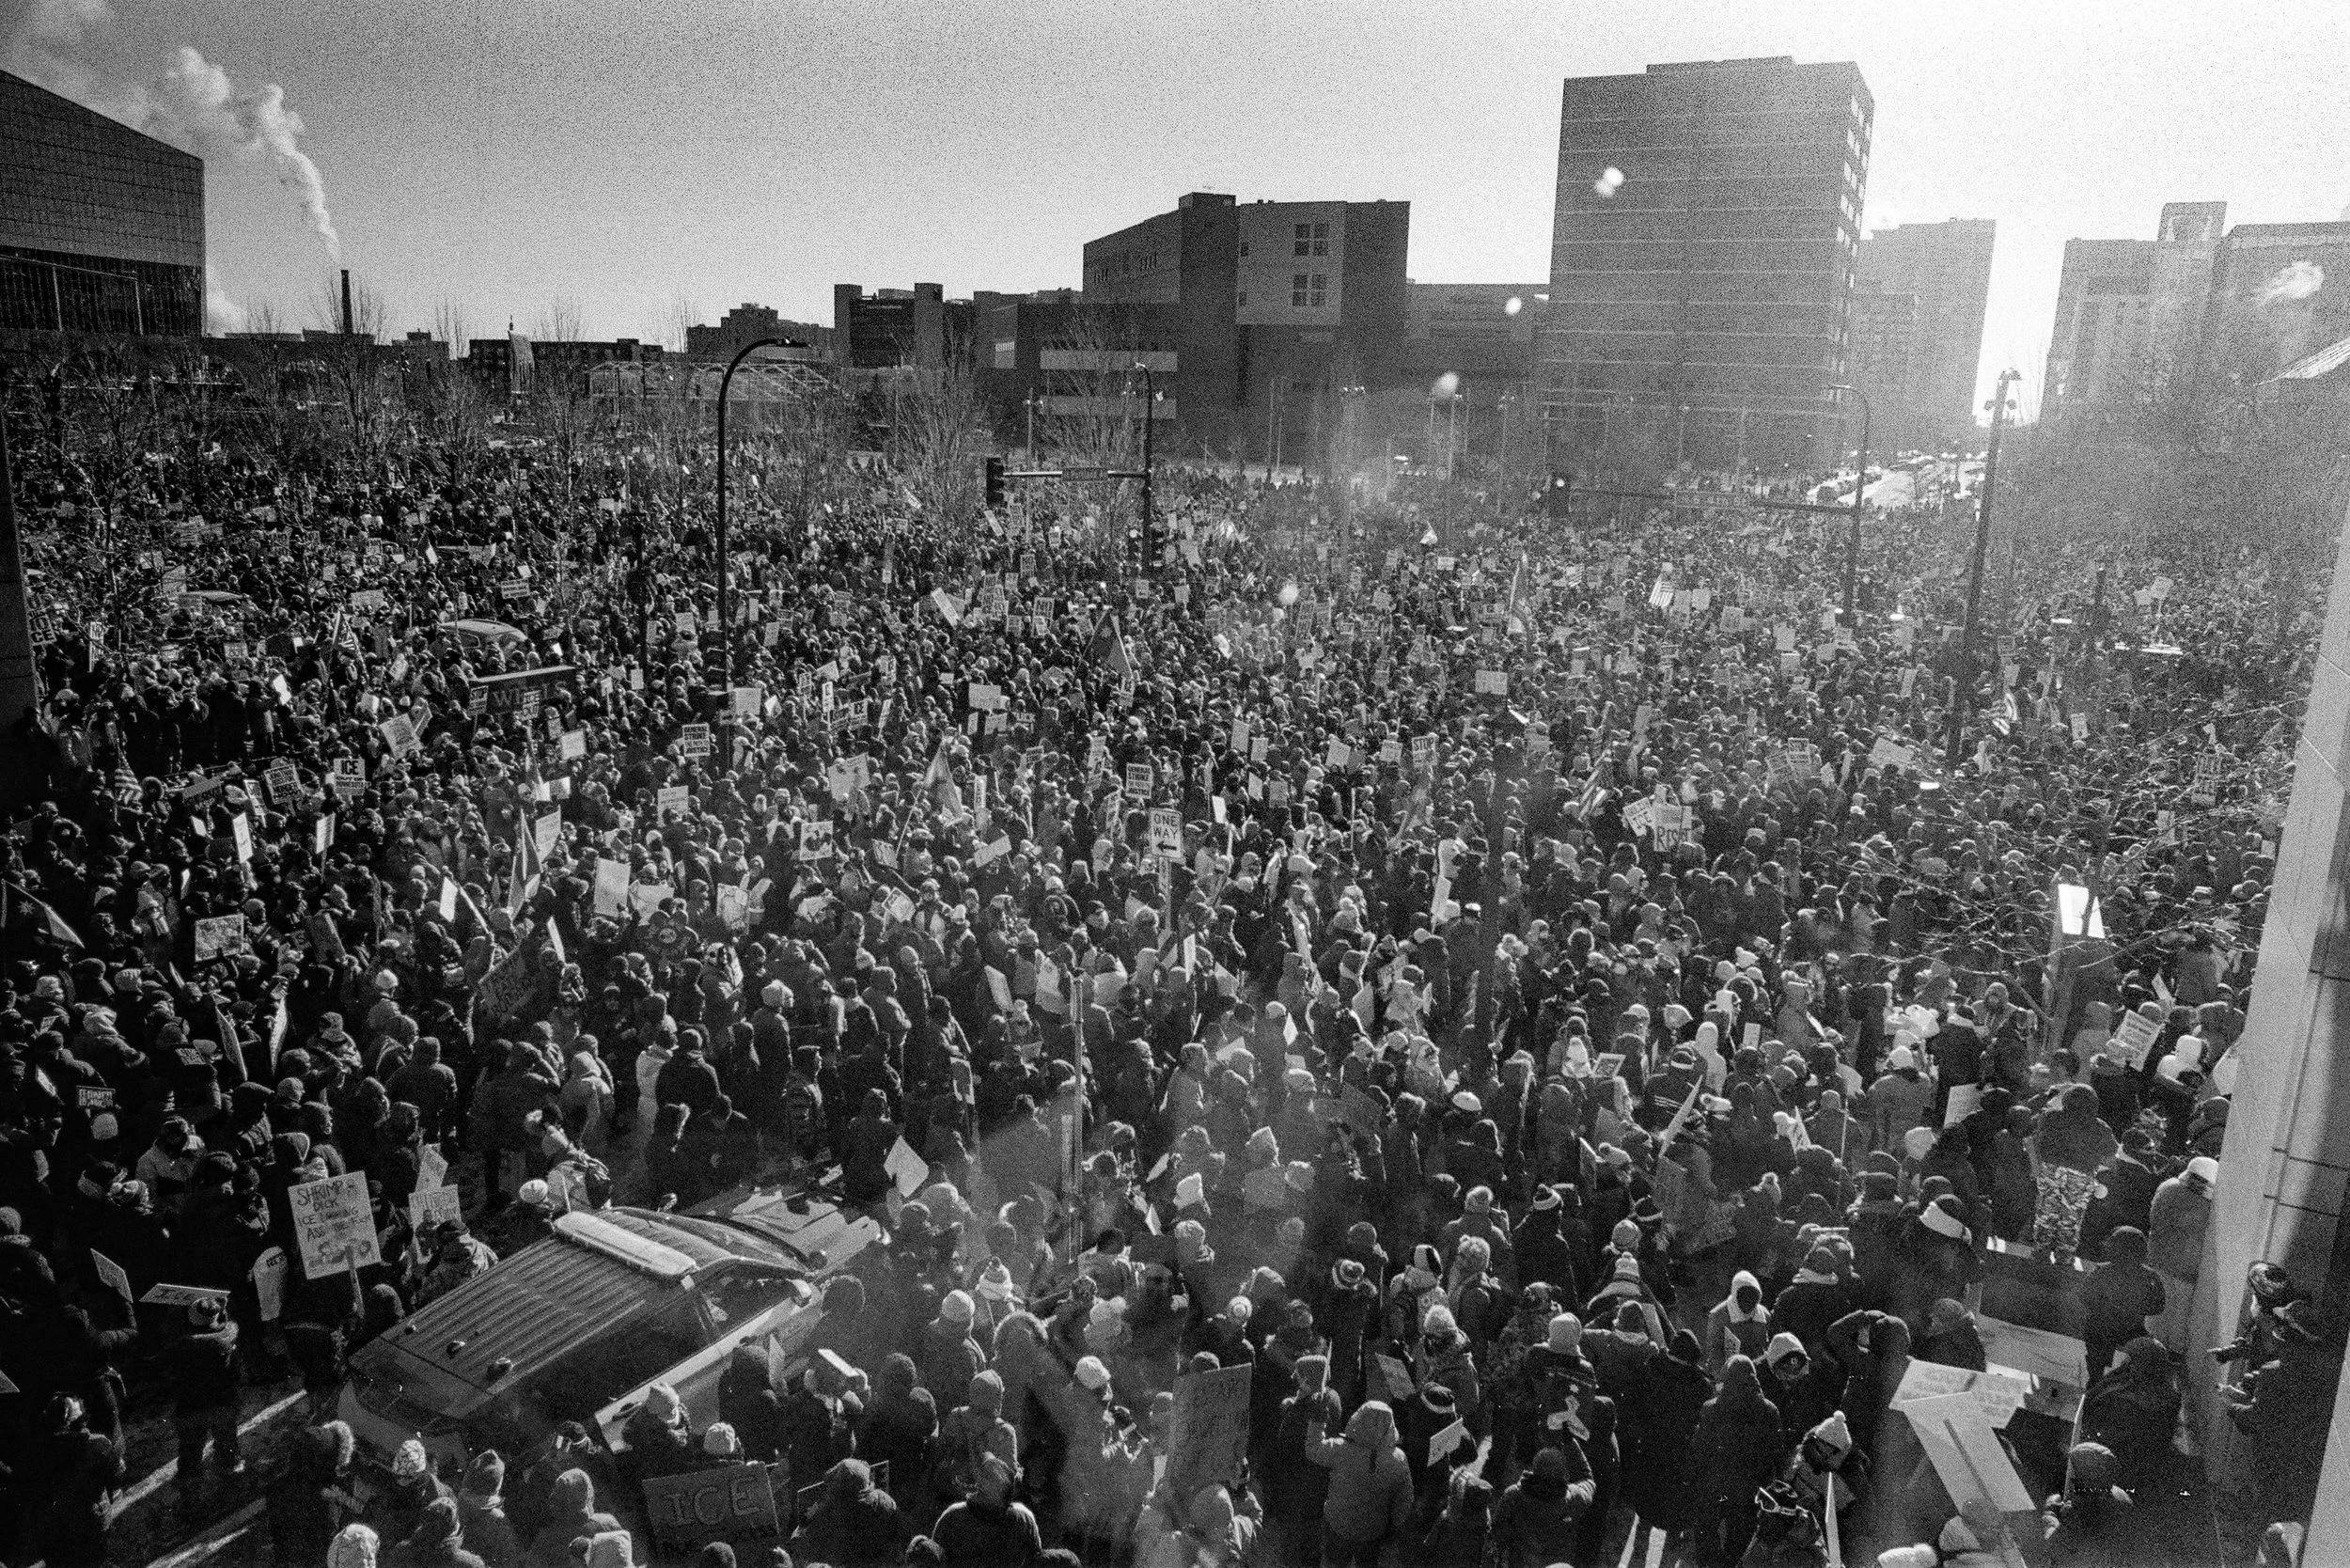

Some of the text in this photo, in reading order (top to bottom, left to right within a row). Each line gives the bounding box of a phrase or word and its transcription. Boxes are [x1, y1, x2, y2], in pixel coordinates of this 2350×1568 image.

[341, 760, 359, 775] ICE
[1153, 813, 1177, 827] ONE
[1633, 810, 1652, 829] ICE
[1152, 827, 1178, 839] WAY
[297, 1181, 343, 1206] SHRIMP
[298, 1215, 316, 1227] ICE
[664, 1477, 760, 1526] ICE
